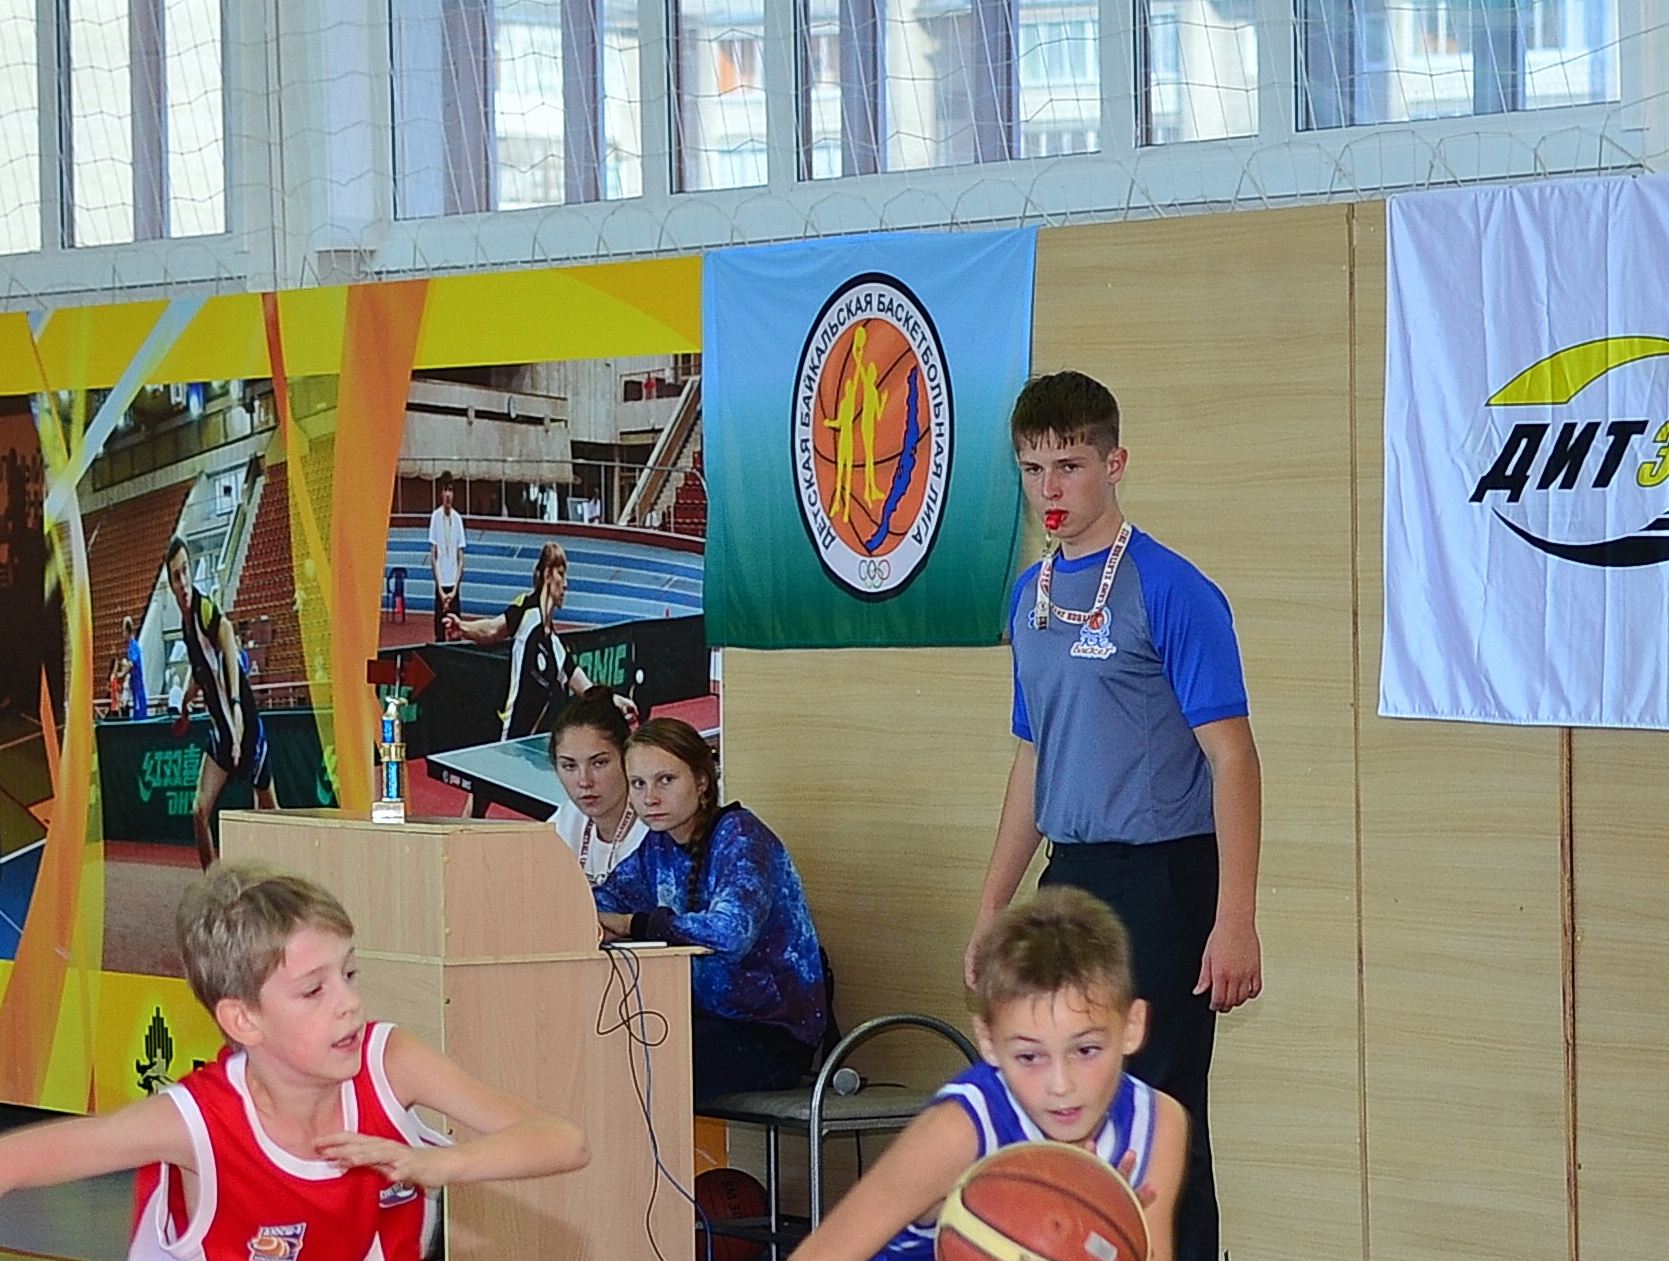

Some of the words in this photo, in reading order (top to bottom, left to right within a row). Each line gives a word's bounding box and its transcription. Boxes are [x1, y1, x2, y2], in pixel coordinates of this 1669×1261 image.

[801, 292, 873, 428] БАЙКАЛЬСКАЯ
[877, 292, 944, 479] БАСКЕТБОЛЬНАЯ
[800, 437, 836, 550] ДЕТСКАЯ
[911, 482, 939, 545] ЛИГА
[570, 643, 628, 692] ONIC
